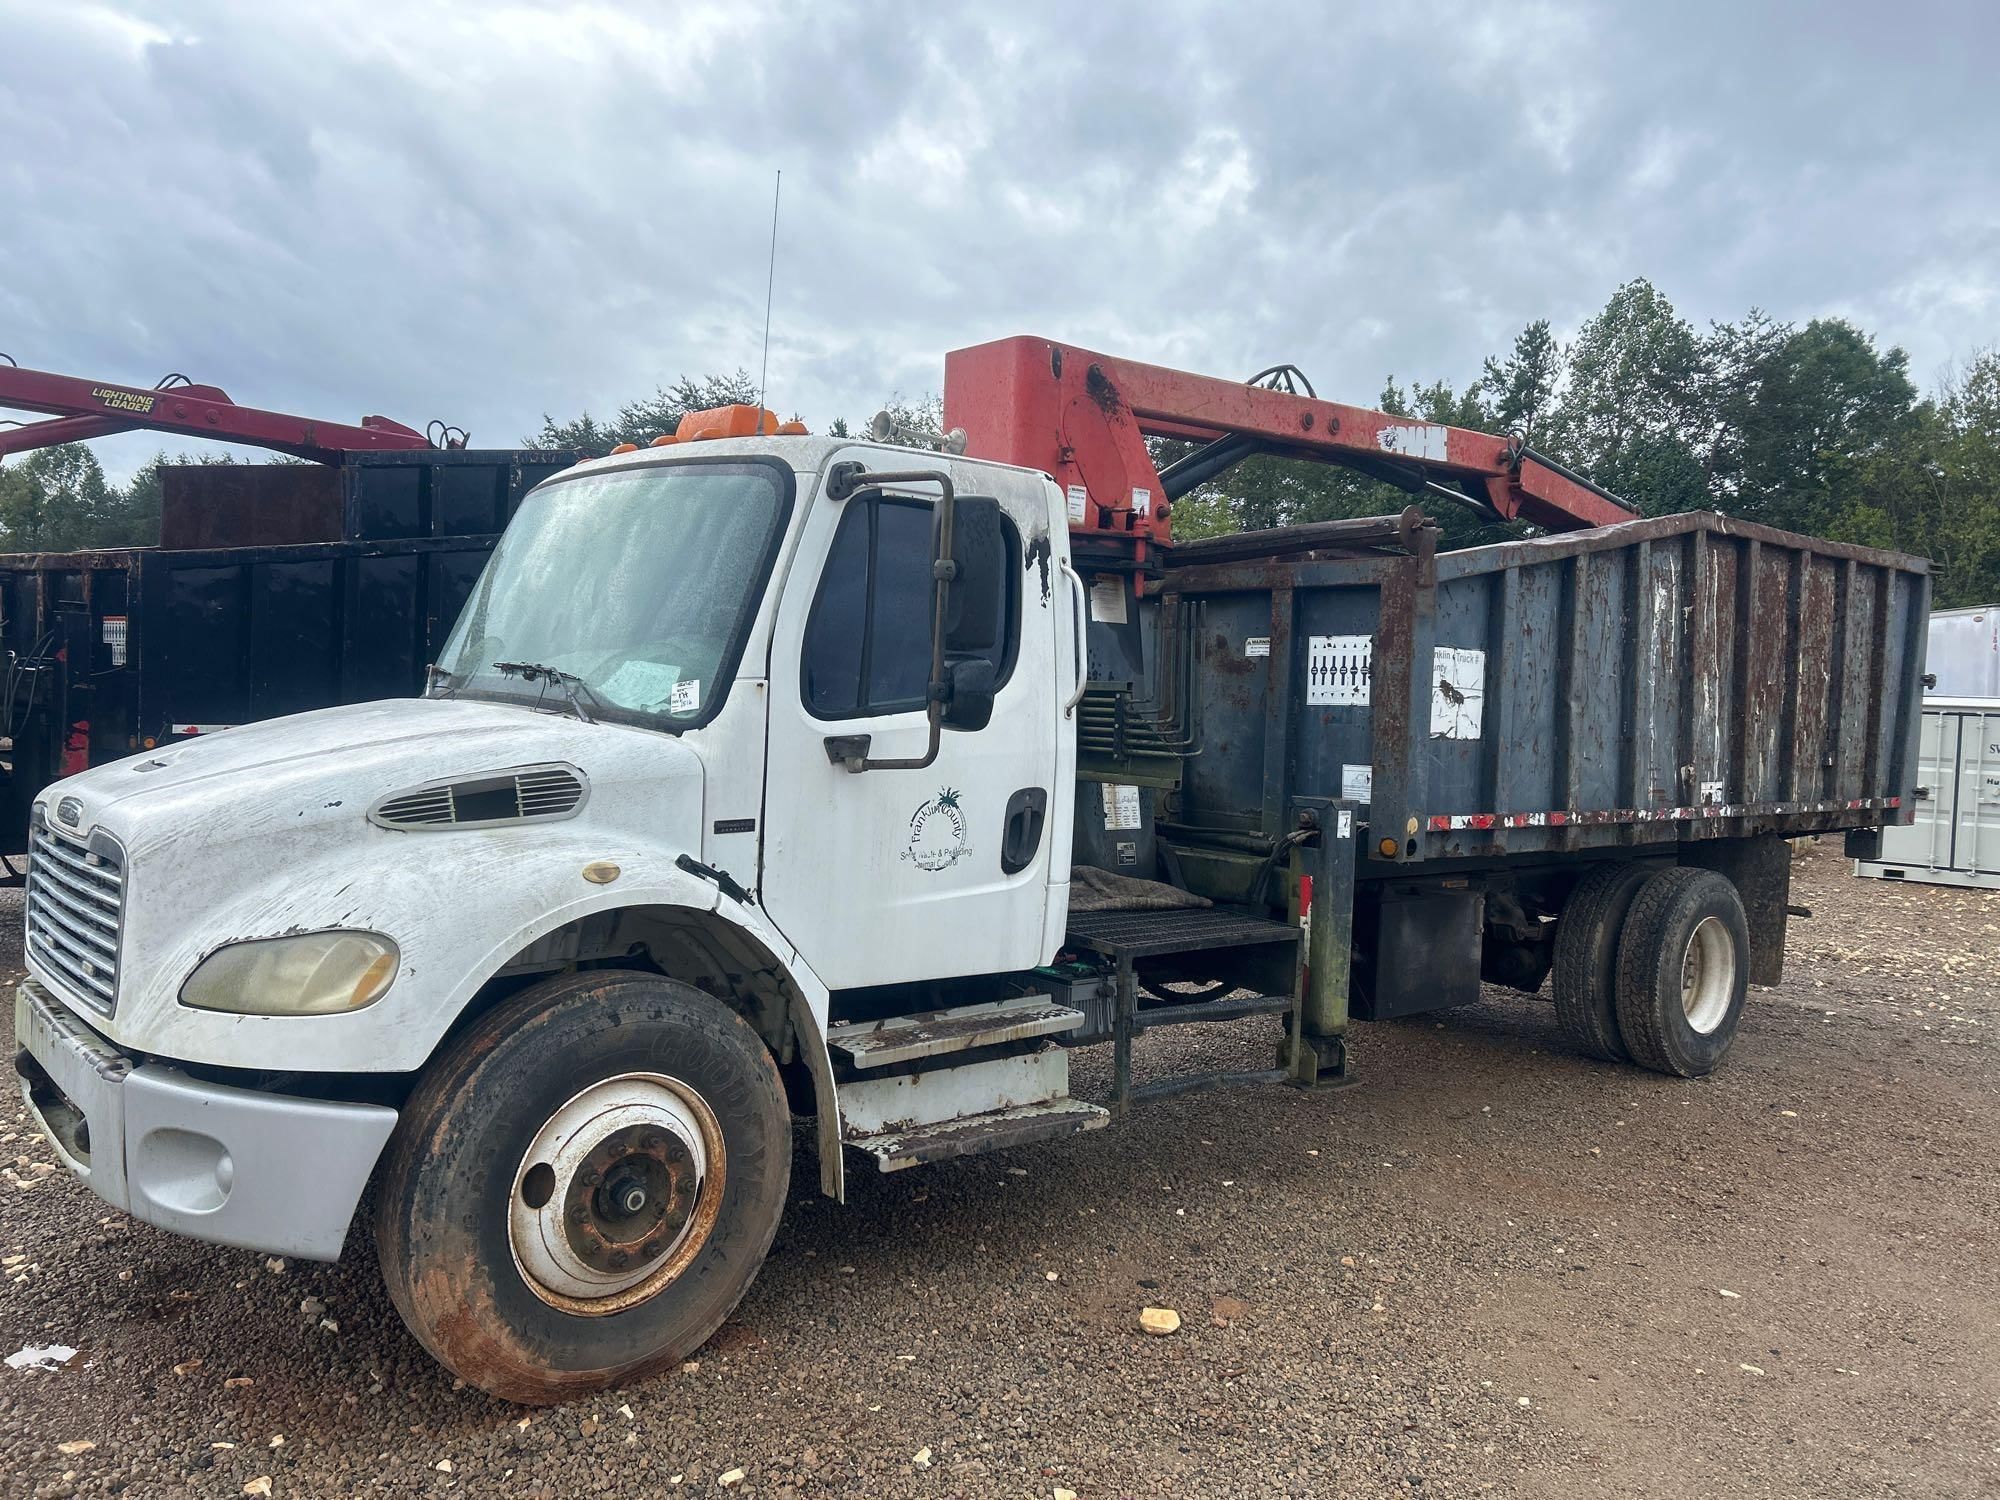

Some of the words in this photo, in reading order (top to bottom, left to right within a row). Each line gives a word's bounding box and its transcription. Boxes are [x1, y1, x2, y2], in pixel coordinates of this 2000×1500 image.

[91, 387, 155, 405] LIGHTNING
[104, 398, 151, 413] LOADER
[1456, 652, 1474, 664] Truck
[911, 803, 940, 843] Franklin
[941, 803, 962, 839] County
